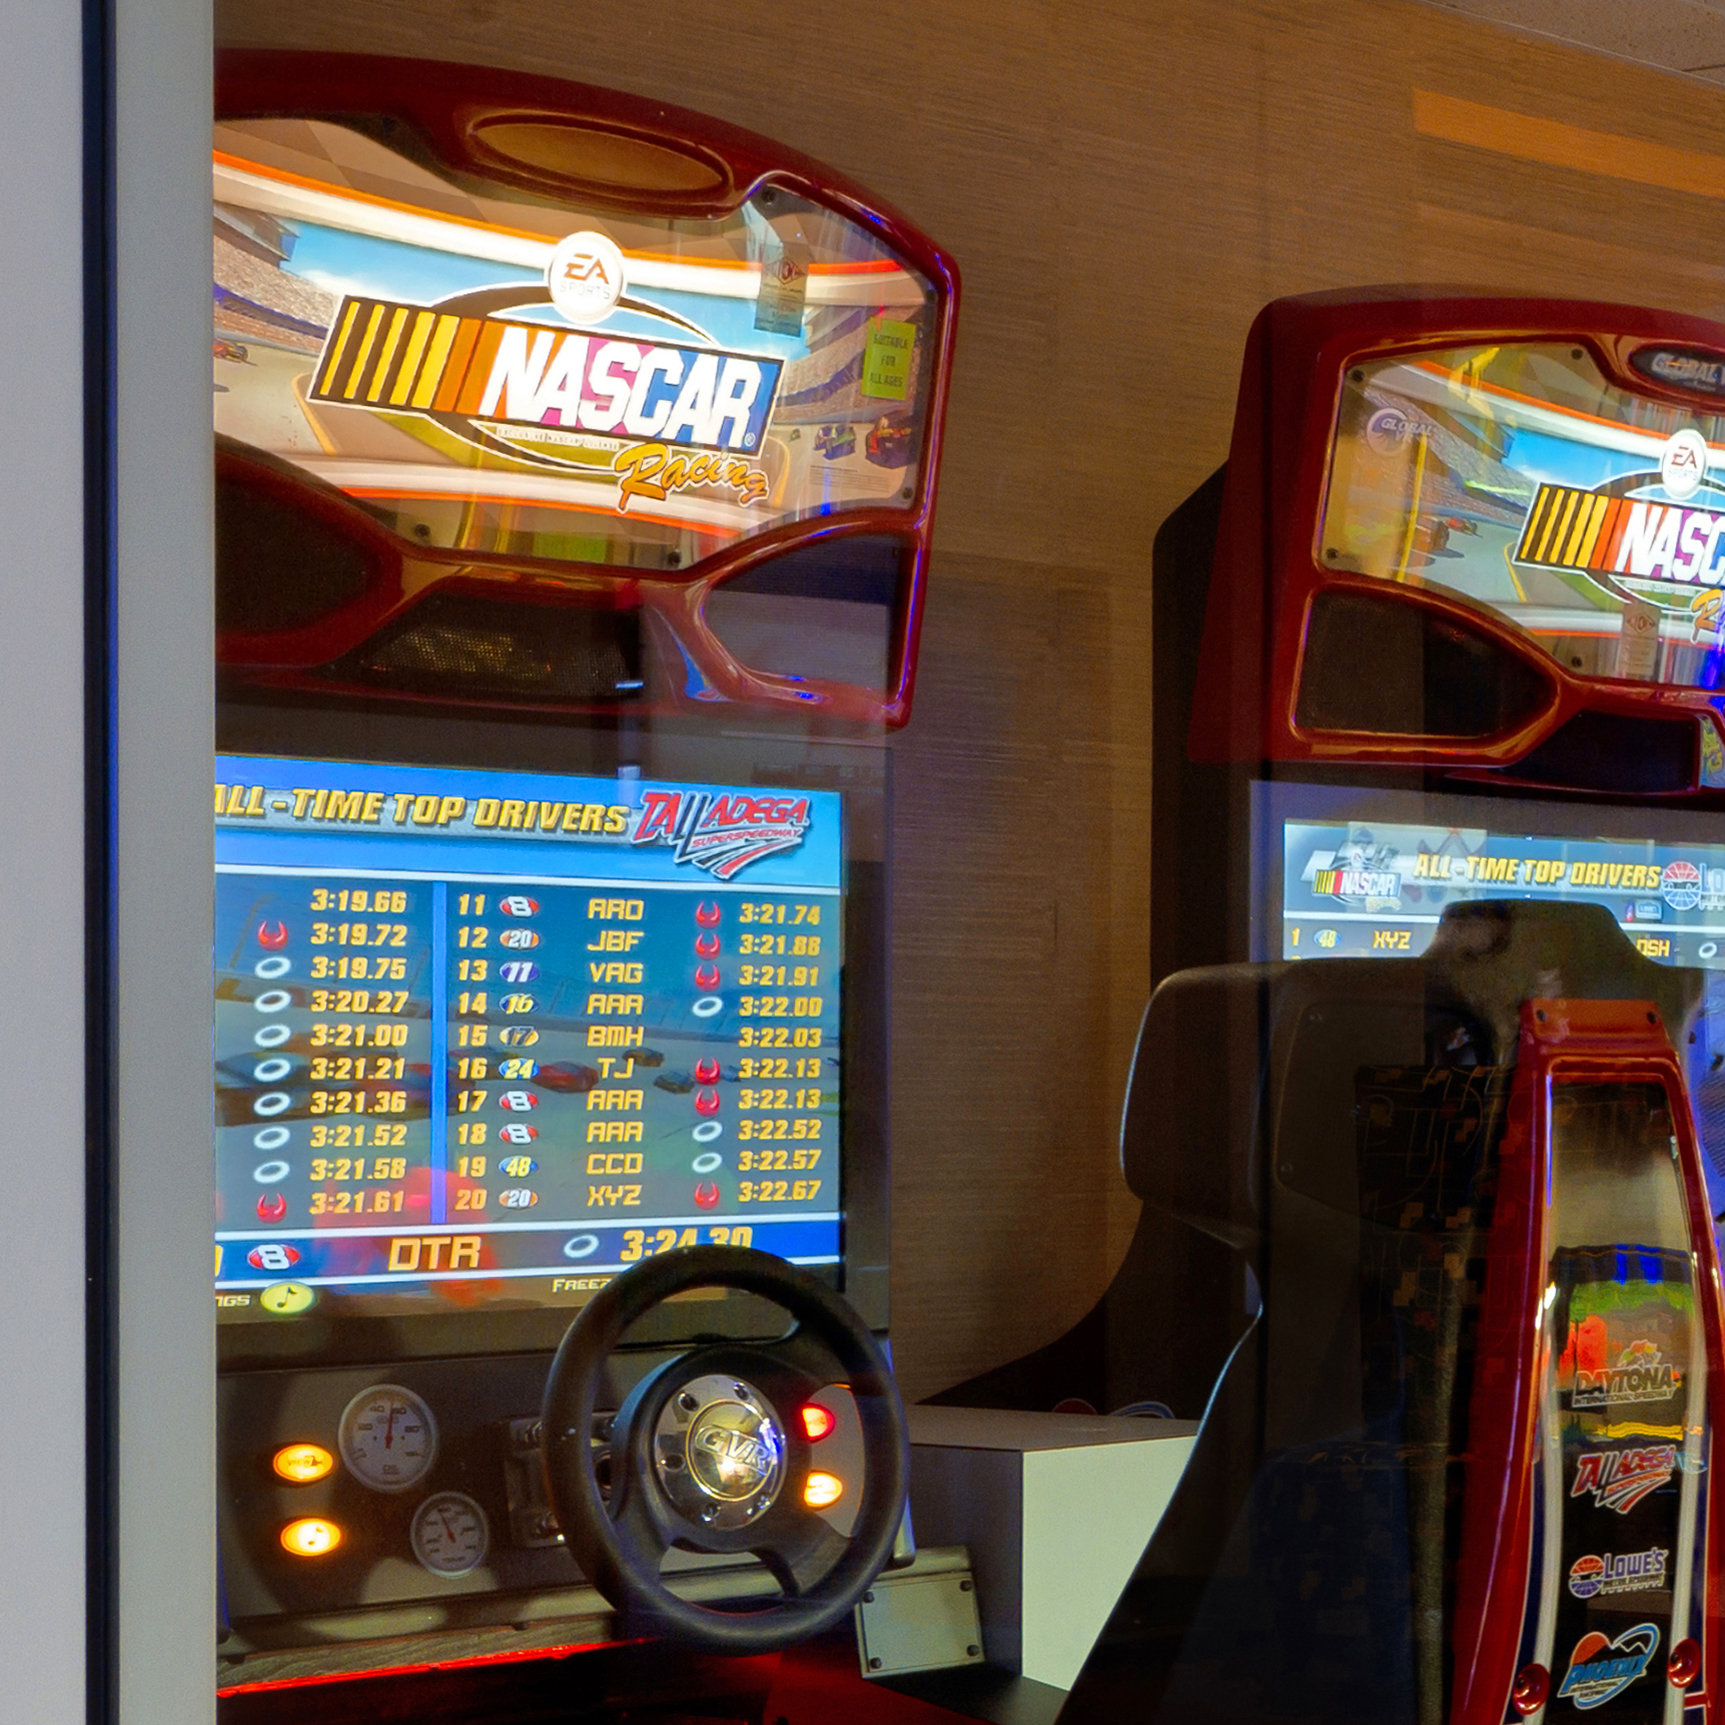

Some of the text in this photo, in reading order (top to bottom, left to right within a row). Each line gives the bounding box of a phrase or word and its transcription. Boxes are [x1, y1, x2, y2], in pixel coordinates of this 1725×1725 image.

[564, 253, 611, 281] EA
[479, 326, 761, 449] NASCAR
[1671, 445, 1697, 468] EA
[614, 443, 769, 511] Racing
[393, 793, 467, 825] TOP
[473, 797, 631, 834] DRIVERS
[632, 789, 812, 858] TALLADEGA
[692, 827, 801, 848] SUPERSPEEDWAY
[1340, 871, 1396, 897] NASCAR
[1523, 858, 1566, 884] TOP
[1569, 860, 1662, 888] DRIVERS
[310, 889, 406, 913] 3:19.66
[458, 893, 486, 915] 11
[511, 896, 533, 918] 8
[738, 903, 821, 925] 3:21.74
[310, 922, 407, 946] 3:19.72
[458, 927, 488, 948] 12
[509, 929, 534, 949] 20
[587, 931, 645, 951] JBF
[1291, 928, 1300, 946] 1
[1373, 931, 1412, 949] XYZ
[310, 956, 406, 980] 3:19.75
[458, 959, 819, 986] 13 11 VAG 3:21.91
[310, 990, 408, 1014] 3:20.27
[458, 993, 822, 1018] 14 16 AAA 3:22.00
[310, 1024, 408, 1047] 3:21.00
[458, 1025, 822, 1049] 15 17 BMH 3:22.03
[310, 1058, 405, 1080] 3:21.21
[458, 1058, 487, 1079] 16
[506, 1058, 533, 1079] 24
[738, 1058, 821, 1079] 3:22.13
[310, 1092, 406, 1114] 3:21.36
[458, 1088, 821, 1112] 17 8 AAA 3:22.13
[310, 1125, 406, 1148] 3:21.52
[458, 1119, 822, 1145] 18 8 AAA 3:22.52
[310, 1159, 406, 1181] 3:21.58
[458, 1156, 487, 1177] 19
[506, 1156, 532, 1177] 48
[738, 1149, 822, 1171] 3:22.57
[310, 1192, 404, 1215] 3:21.61
[455, 1180, 821, 1210] 20 20 XYZ 3:22.67
[257, 1244, 290, 1270] 8
[389, 1236, 481, 1272] DTR
[1575, 1364, 1674, 1398] DAYTONA
[699, 1426, 771, 1475] GVR
[1603, 1549, 1667, 1580] LOWE'S
